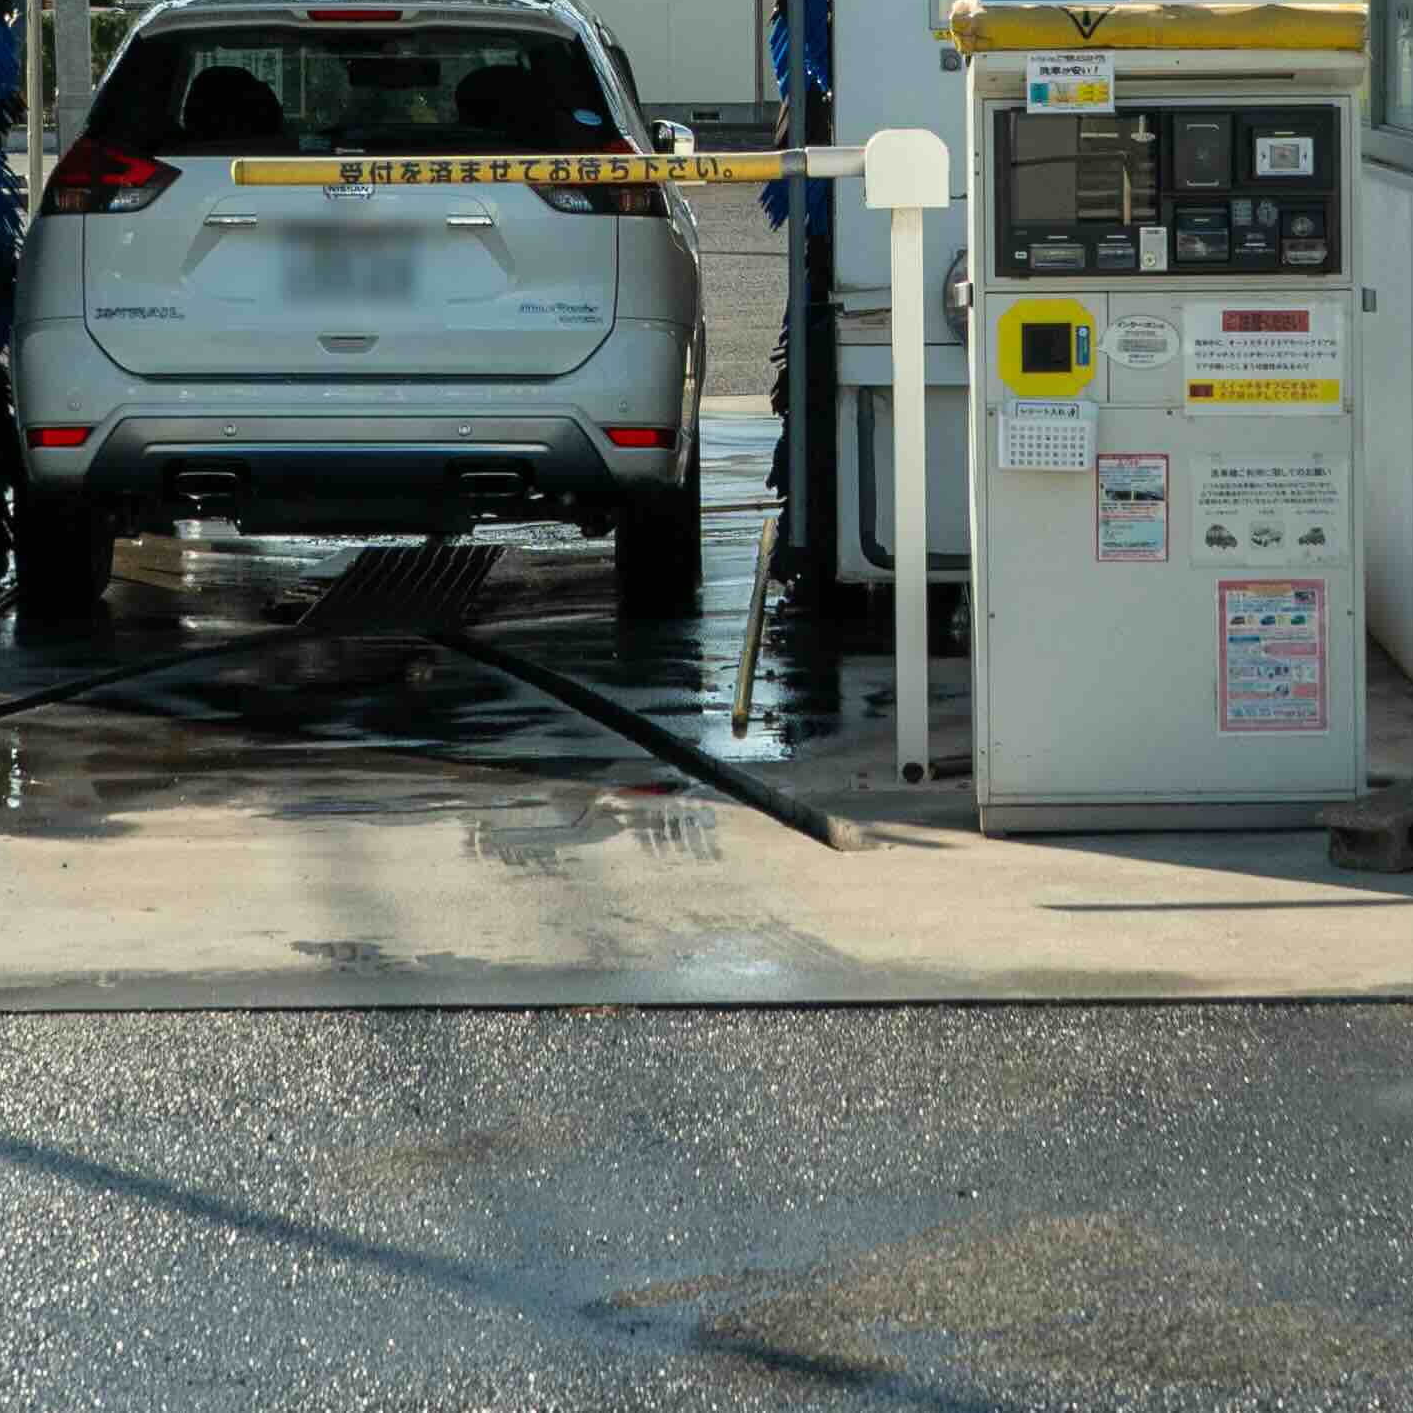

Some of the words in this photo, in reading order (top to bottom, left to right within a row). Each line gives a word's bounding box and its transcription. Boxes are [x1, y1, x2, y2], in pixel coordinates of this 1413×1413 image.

[339, 156, 734, 183] 受付を済ませてお待ち下さい。
